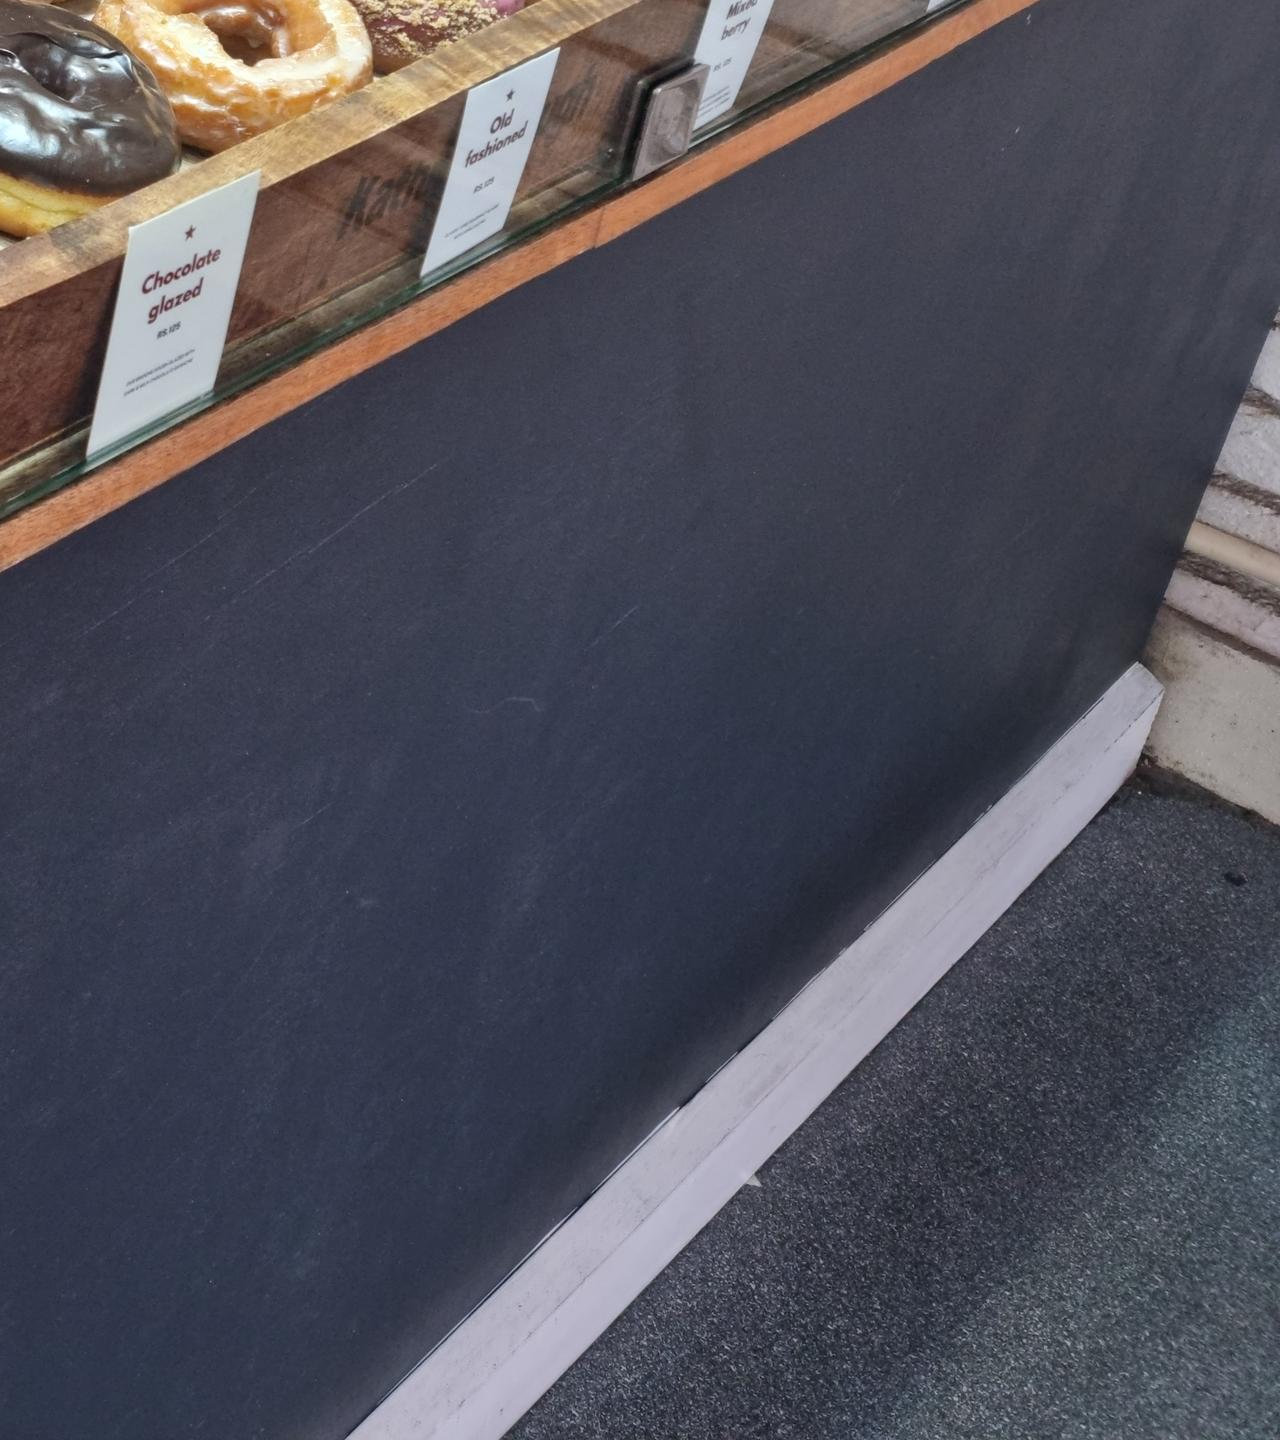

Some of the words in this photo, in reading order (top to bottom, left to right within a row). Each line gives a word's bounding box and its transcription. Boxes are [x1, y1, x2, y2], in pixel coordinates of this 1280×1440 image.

[721, 17, 751, 41] berry
[465, 120, 528, 168] fashioned
[490, 108, 514, 134] Old
[142, 248, 221, 294] Chocolate
[147, 277, 204, 324] glazed
